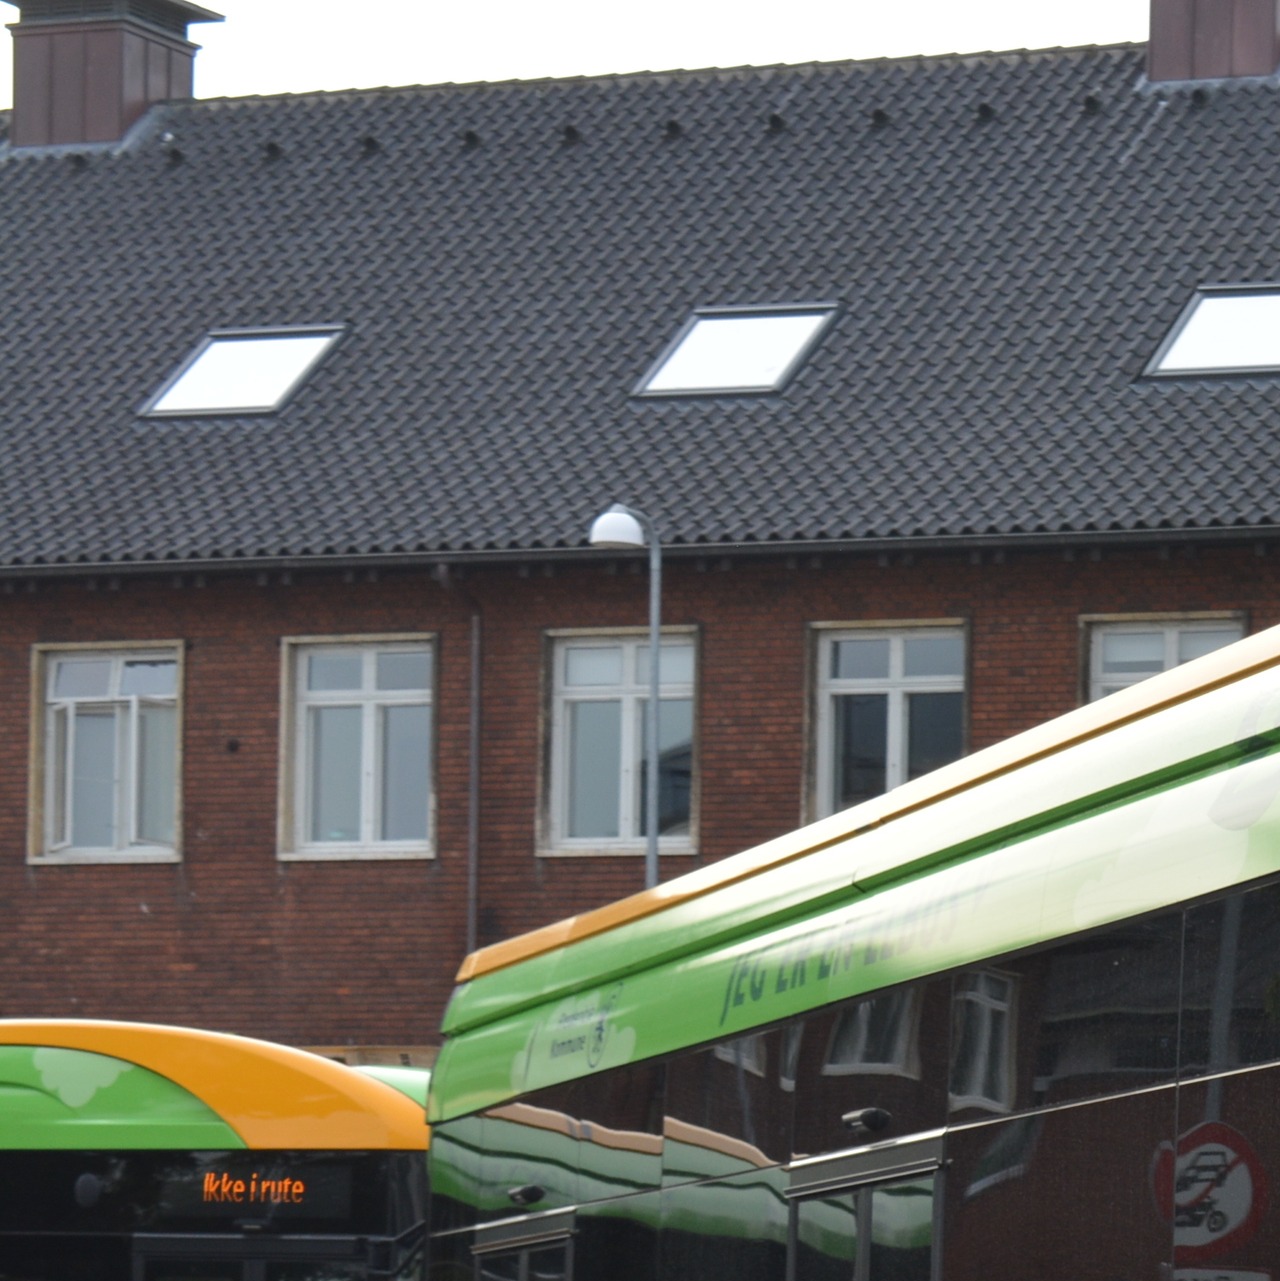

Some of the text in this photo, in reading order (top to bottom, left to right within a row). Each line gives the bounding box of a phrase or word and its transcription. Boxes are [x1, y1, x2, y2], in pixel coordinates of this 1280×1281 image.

[203, 1172, 305, 1204] Ikke i rute
